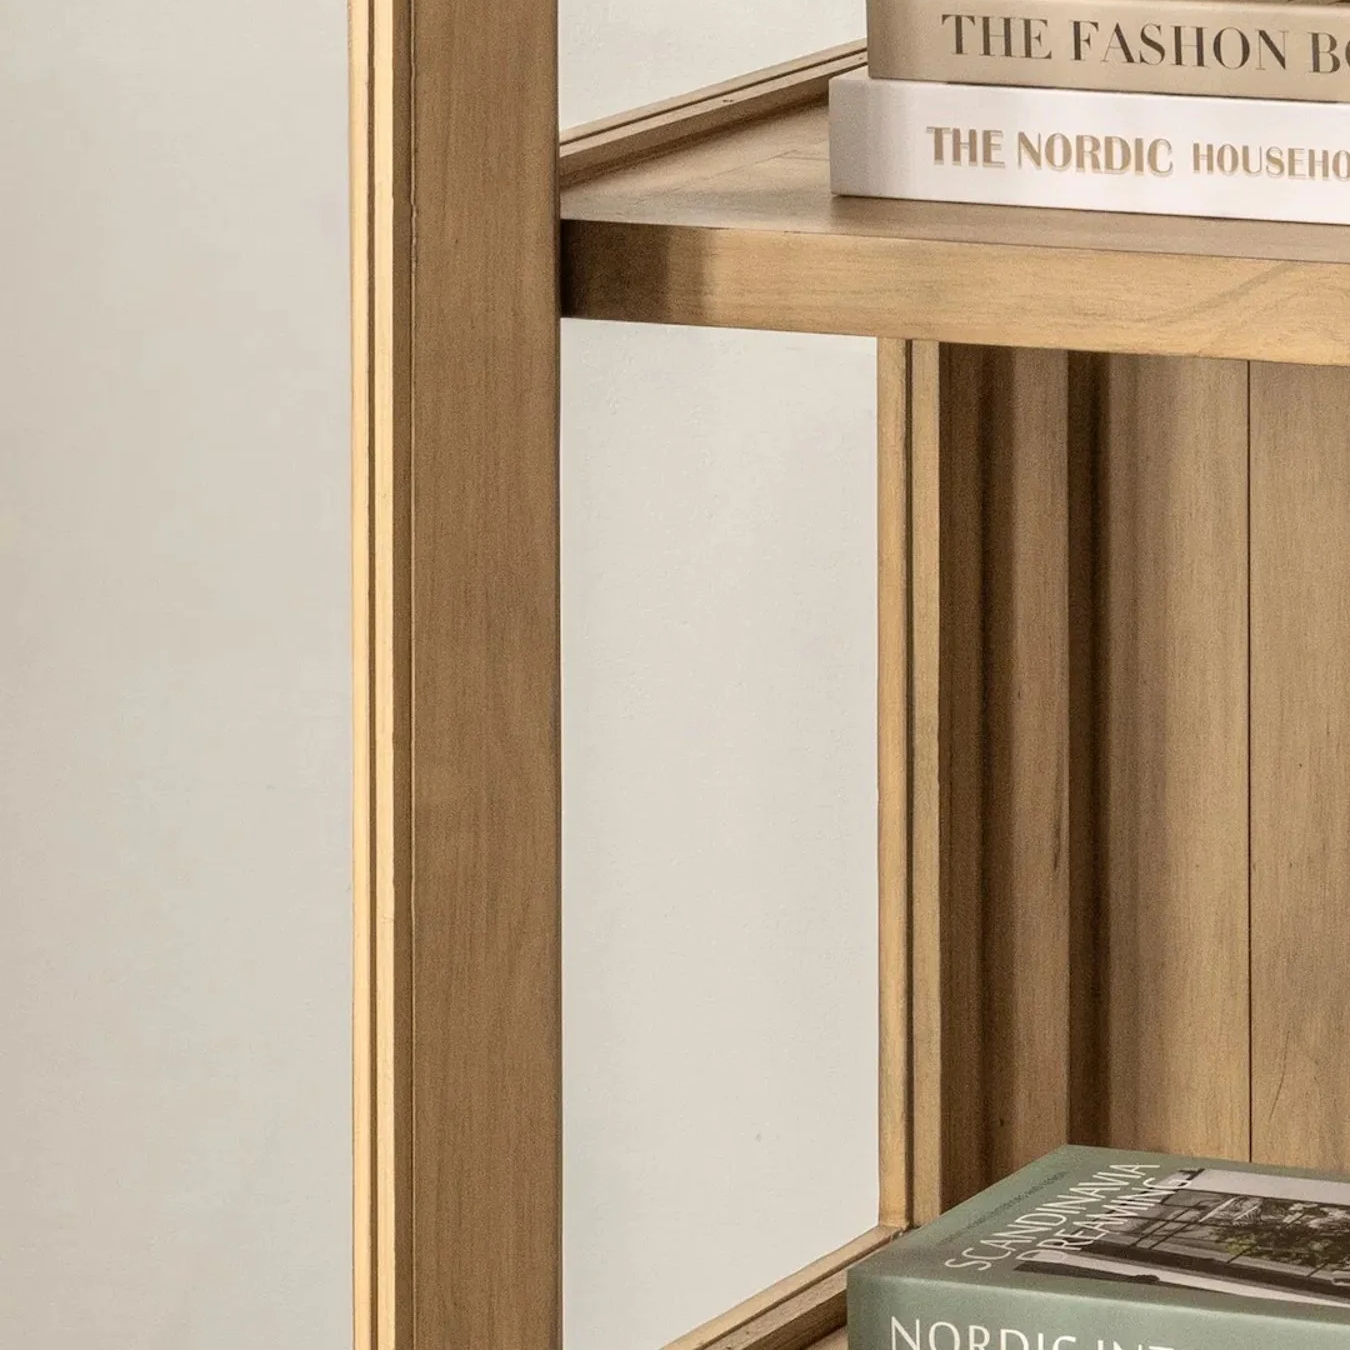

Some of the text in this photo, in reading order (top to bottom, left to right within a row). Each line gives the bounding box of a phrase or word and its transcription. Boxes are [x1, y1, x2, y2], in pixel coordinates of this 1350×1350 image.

[941, 14, 1052, 60] THE
[926, 126, 1006, 169] THE
[1017, 131, 1174, 178] NORDIC
[944, 1163, 1161, 1271] SCANDINAVIA
[1015, 1177, 1192, 1261] DREAMING
